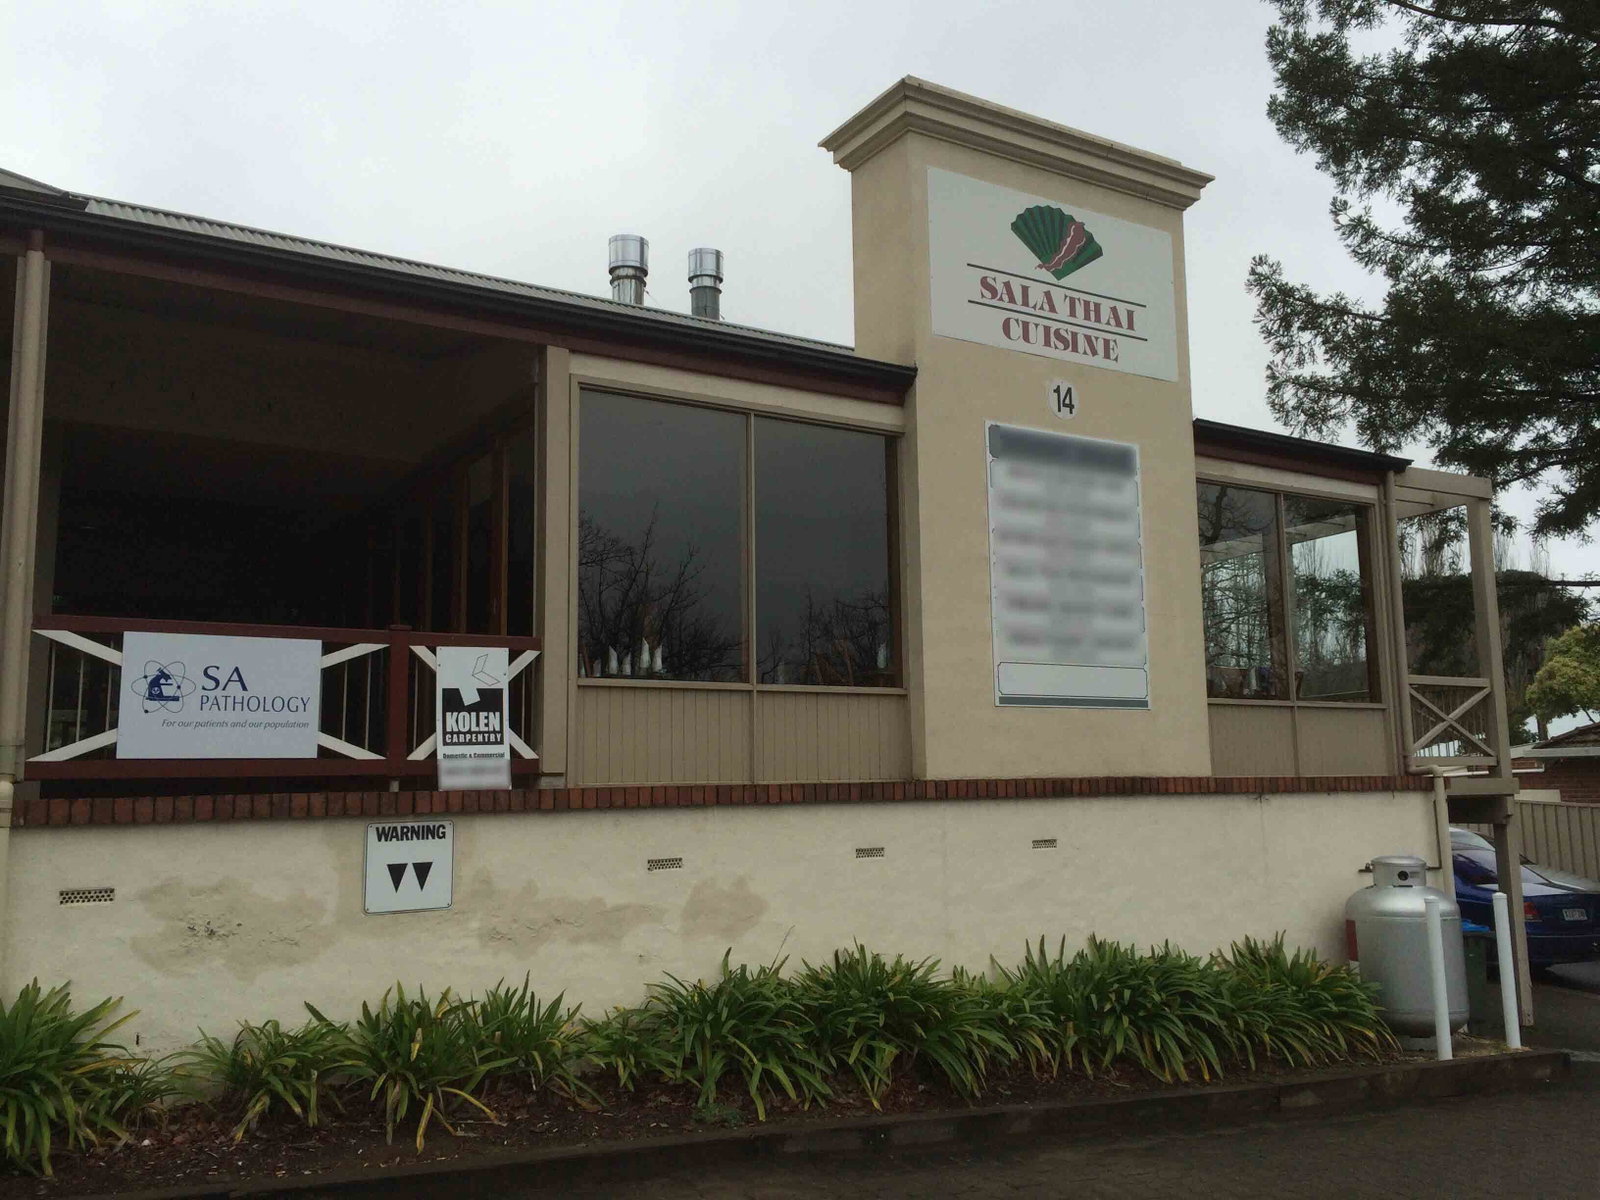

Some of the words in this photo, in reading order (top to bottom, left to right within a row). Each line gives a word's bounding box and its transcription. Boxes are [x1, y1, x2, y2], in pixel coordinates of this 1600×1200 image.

[980, 275, 1058, 315] SALA
[1064, 293, 1136, 331] THAI
[1002, 317, 1119, 363] CUISINE
[1053, 384, 1075, 414] 14
[201, 665, 248, 692] SA
[200, 694, 311, 713] PATHOLOGY
[161, 719, 176, 728] For
[177, 720, 194, 728] our
[194, 719, 229, 730] patients
[229, 720, 247, 729] and
[248, 721, 263, 729] our
[263, 720, 310, 730] population
[446, 711, 500, 732] KOLEN
[445, 733, 501, 743] CARPENTRY
[375, 824, 446, 842] WARNING
